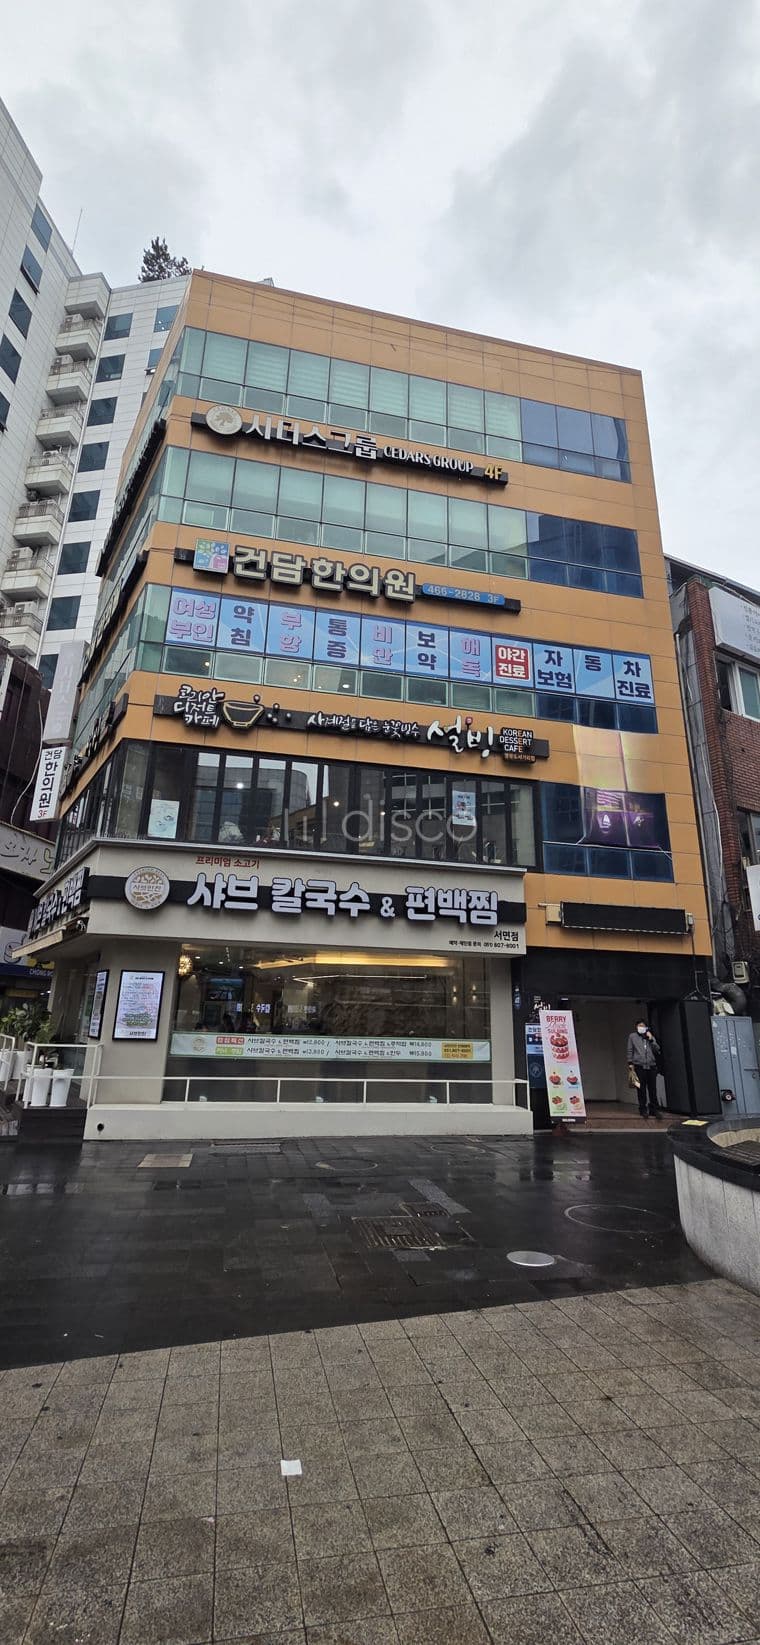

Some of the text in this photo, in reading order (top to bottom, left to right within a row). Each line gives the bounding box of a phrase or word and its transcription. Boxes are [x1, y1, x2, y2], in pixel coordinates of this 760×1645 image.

[246, 415, 503, 480] 시더스그룹 CEDARS GROUP 4F
[234, 545, 416, 602] 건담한의원
[487, 594, 501, 604] 3F
[173, 598, 216, 619] 여성
[170, 619, 213, 642] 부인
[498, 647, 525, 662] 야간
[498, 662, 526, 678] 진료
[537, 669, 652, 699] 보험 진료
[179, 685, 224, 704] 코리안
[174, 701, 215, 715] 디저트
[184, 713, 220, 728] 카페
[427, 715, 494, 758] 설빙
[499, 736, 532, 746] DESSERT
[503, 728, 533, 739] KOREAN
[504, 744, 523, 753] CAFE
[39, 761, 58, 808] 한의원
[38, 810, 48, 818] 3F
[196, 855, 260, 869] 프리미엄 소고기
[187, 872, 499, 925] 샤브 칼국수 & 편백찜
[494, 930, 519, 942] 서면점
